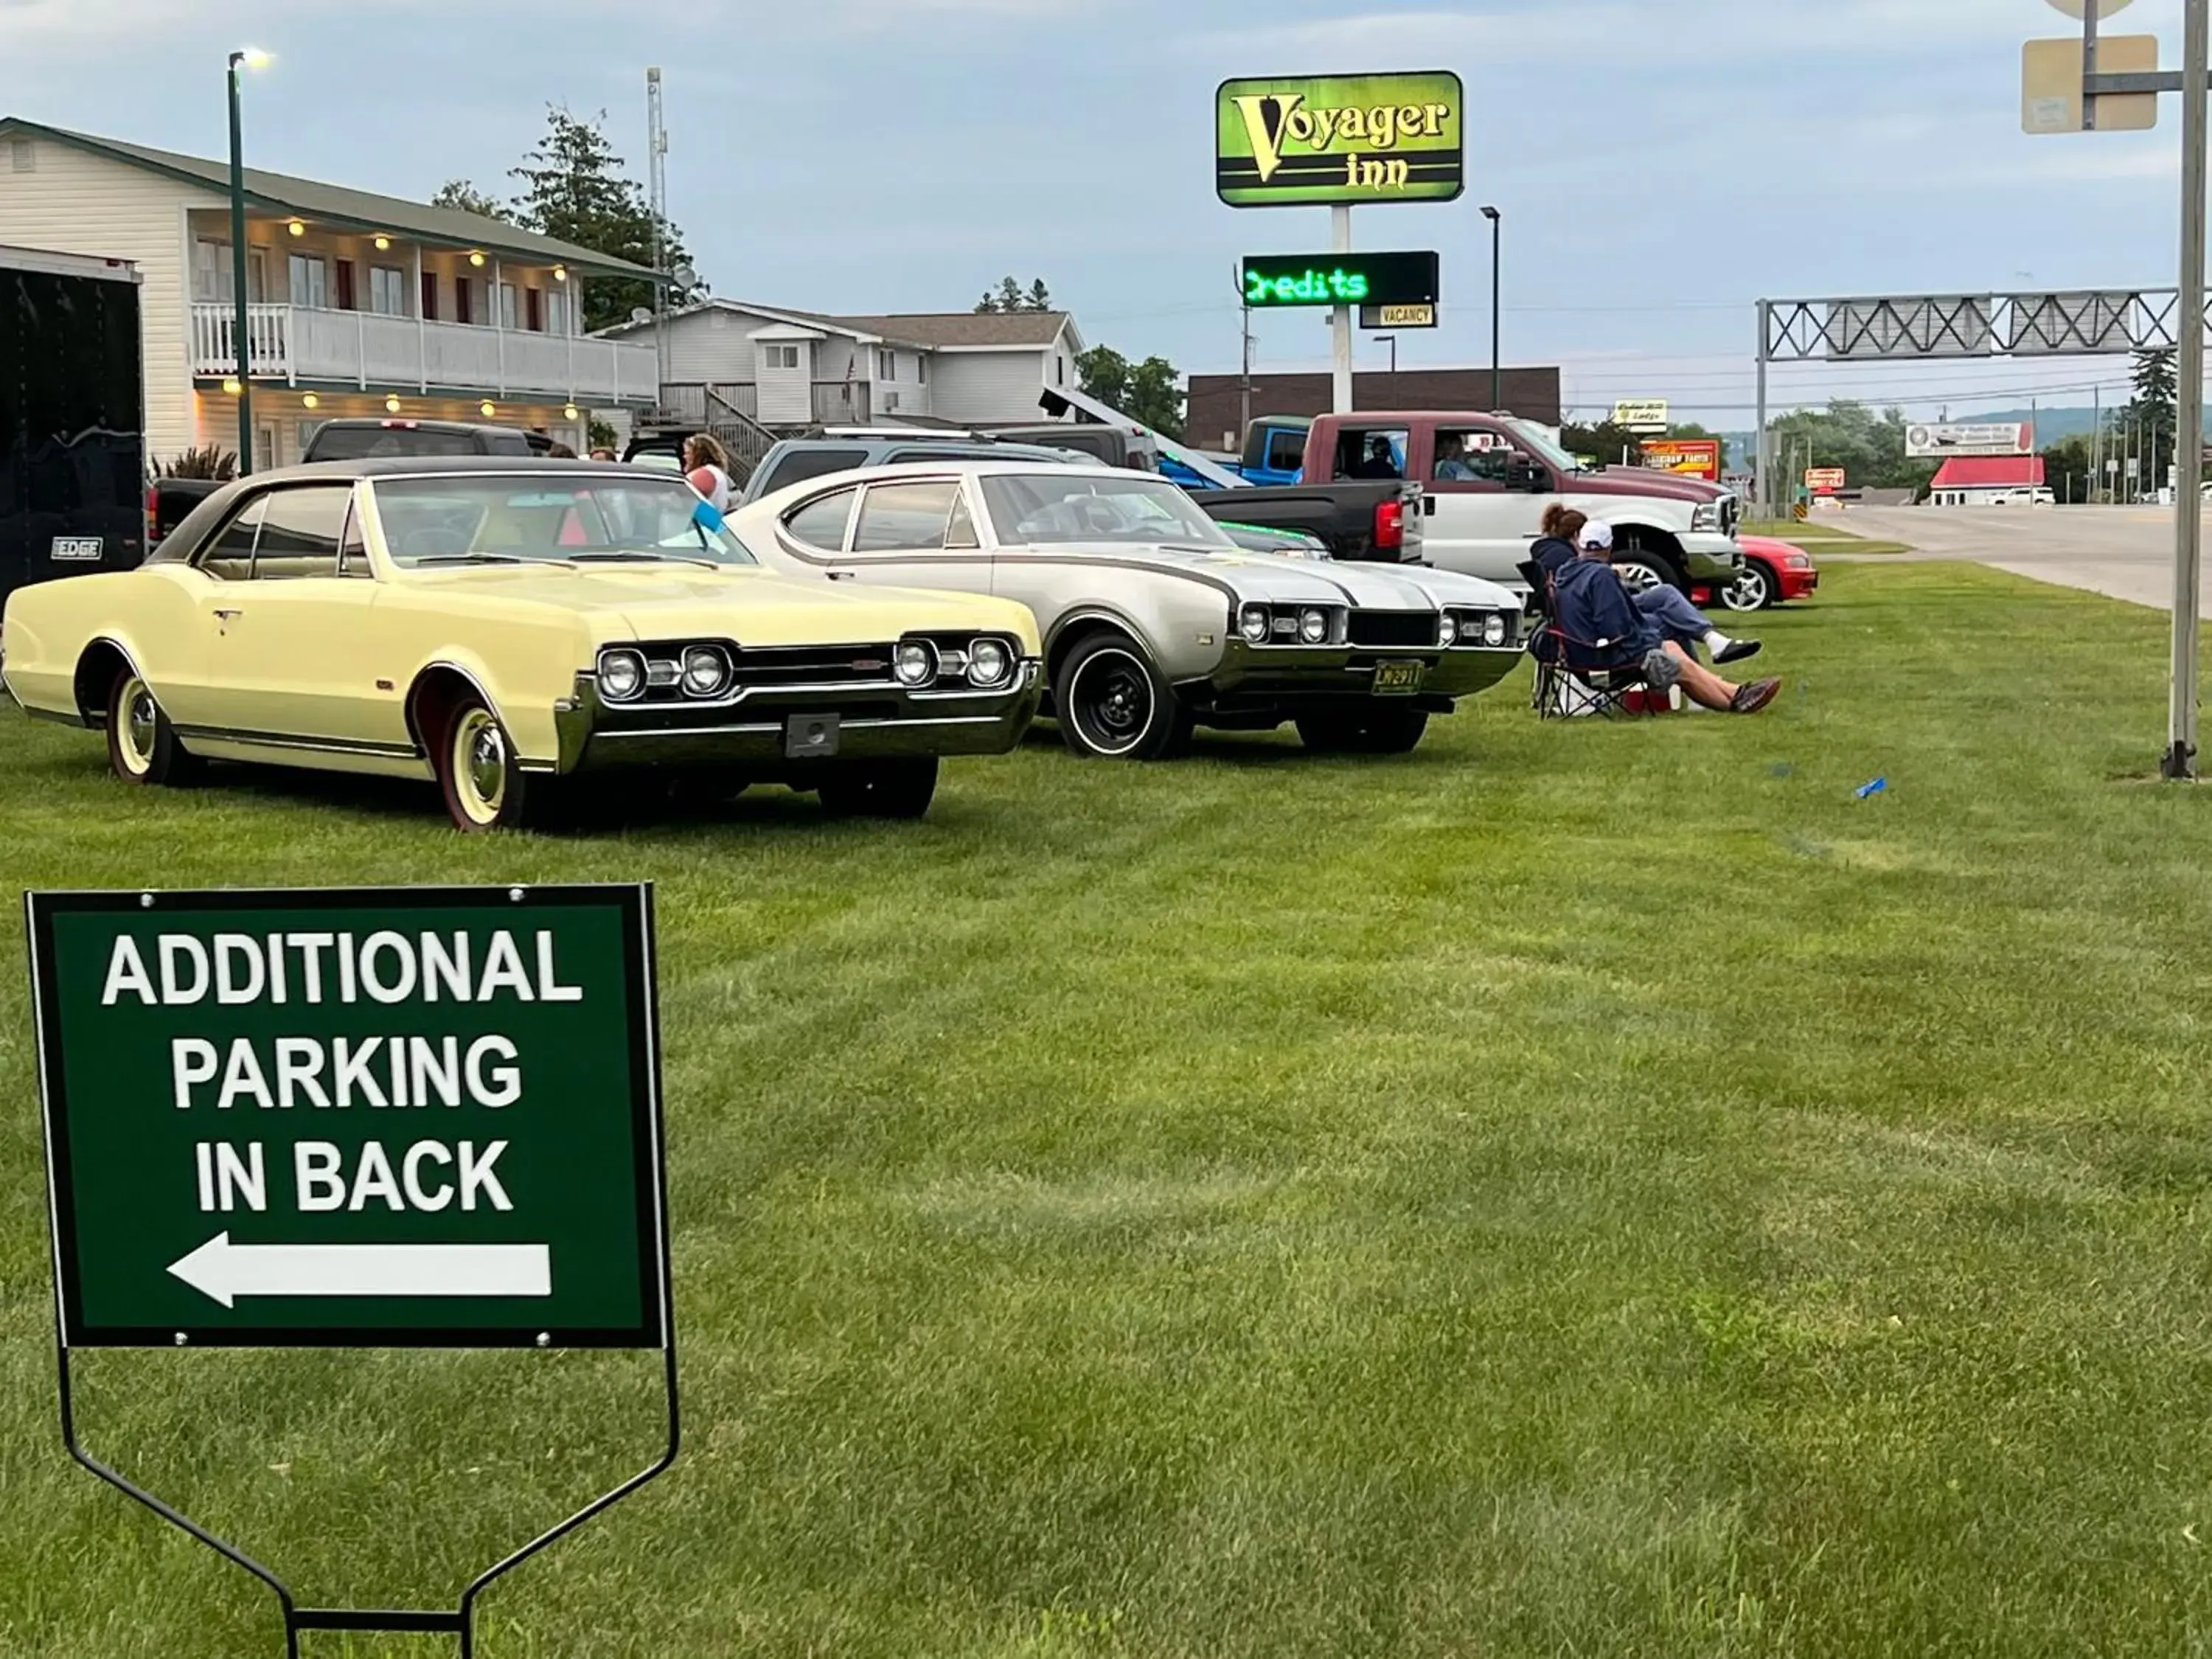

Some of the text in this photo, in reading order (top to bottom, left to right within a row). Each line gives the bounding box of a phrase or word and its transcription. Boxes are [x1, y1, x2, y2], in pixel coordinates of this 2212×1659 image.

[1231, 93, 1450, 183] Voyager
[1346, 153, 1410, 192] inn
[1383, 307, 1430, 322] VACANCY
[58, 540, 100, 557] EDGE
[102, 931, 582, 1004] ADDITIONAL
[173, 1035, 521, 1107] PARKING
[197, 1141, 513, 1210] IN BACK
